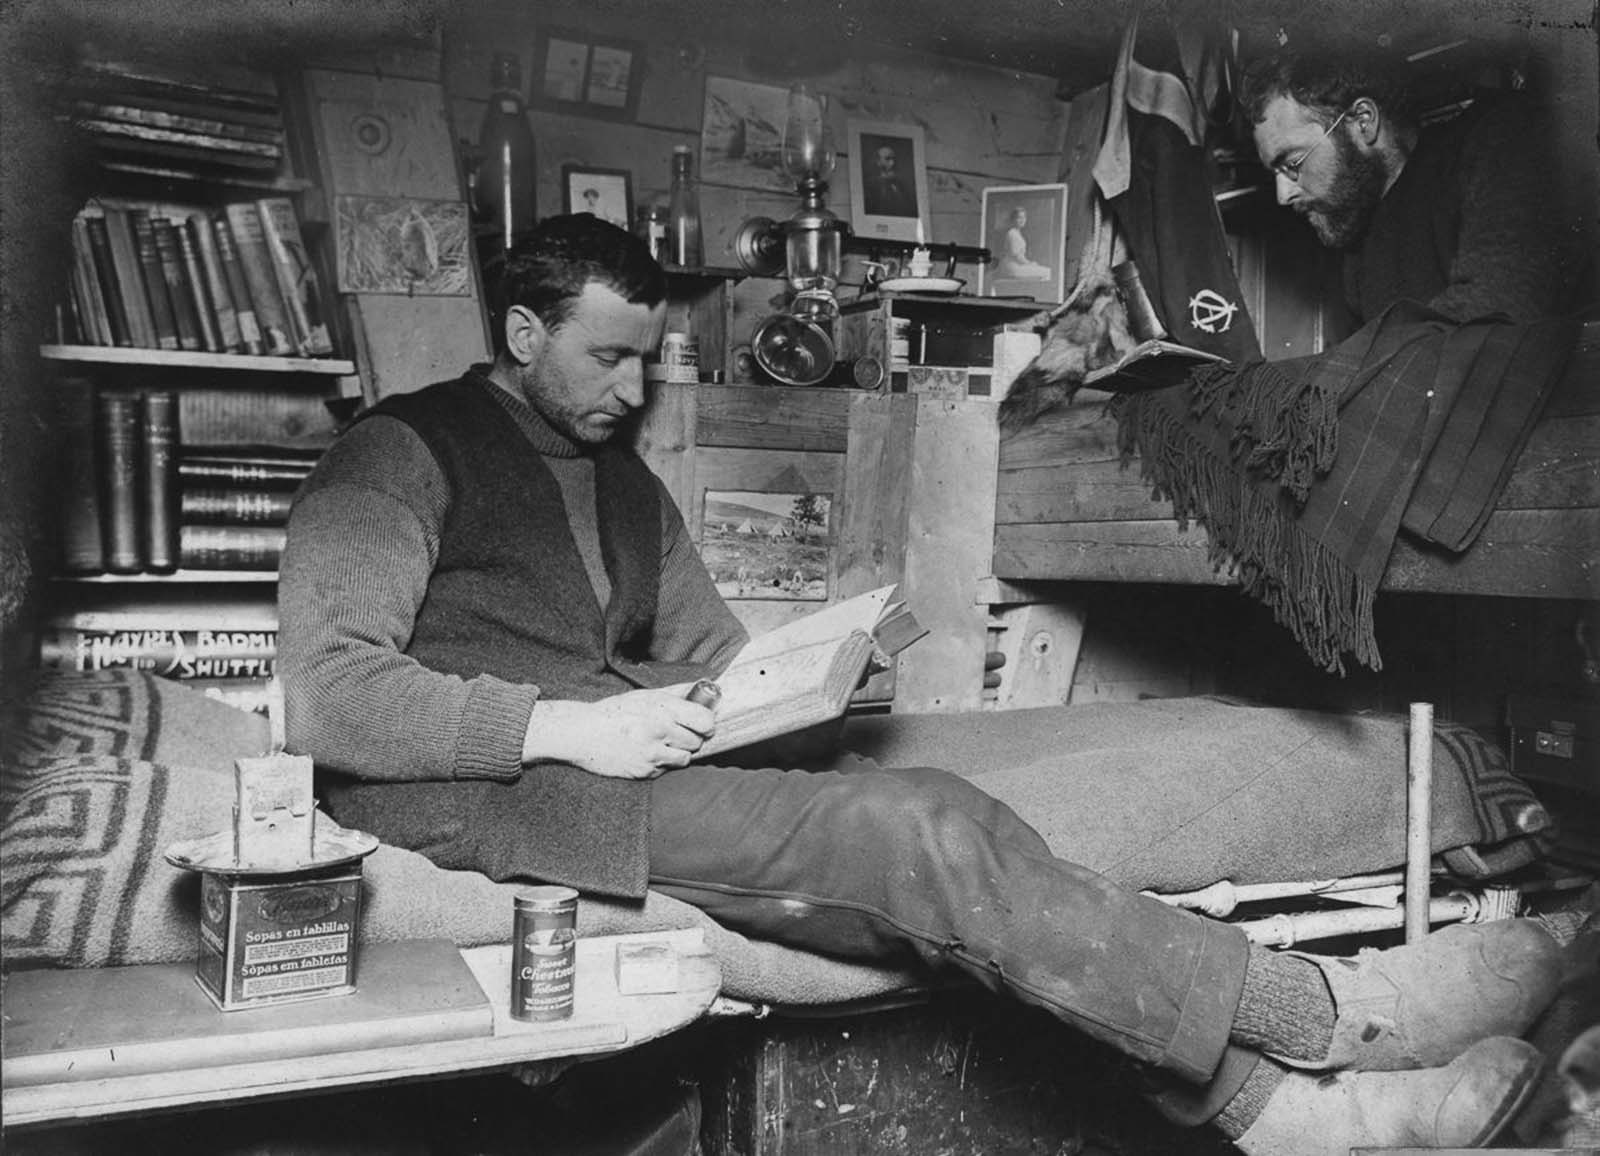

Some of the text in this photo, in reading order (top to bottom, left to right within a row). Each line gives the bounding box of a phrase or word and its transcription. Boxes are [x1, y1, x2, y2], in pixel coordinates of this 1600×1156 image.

[245, 930, 282, 944] Sopas
[286, 926, 300, 937] en
[279, 960, 299, 972] em
[300, 954, 348, 969] tabletas
